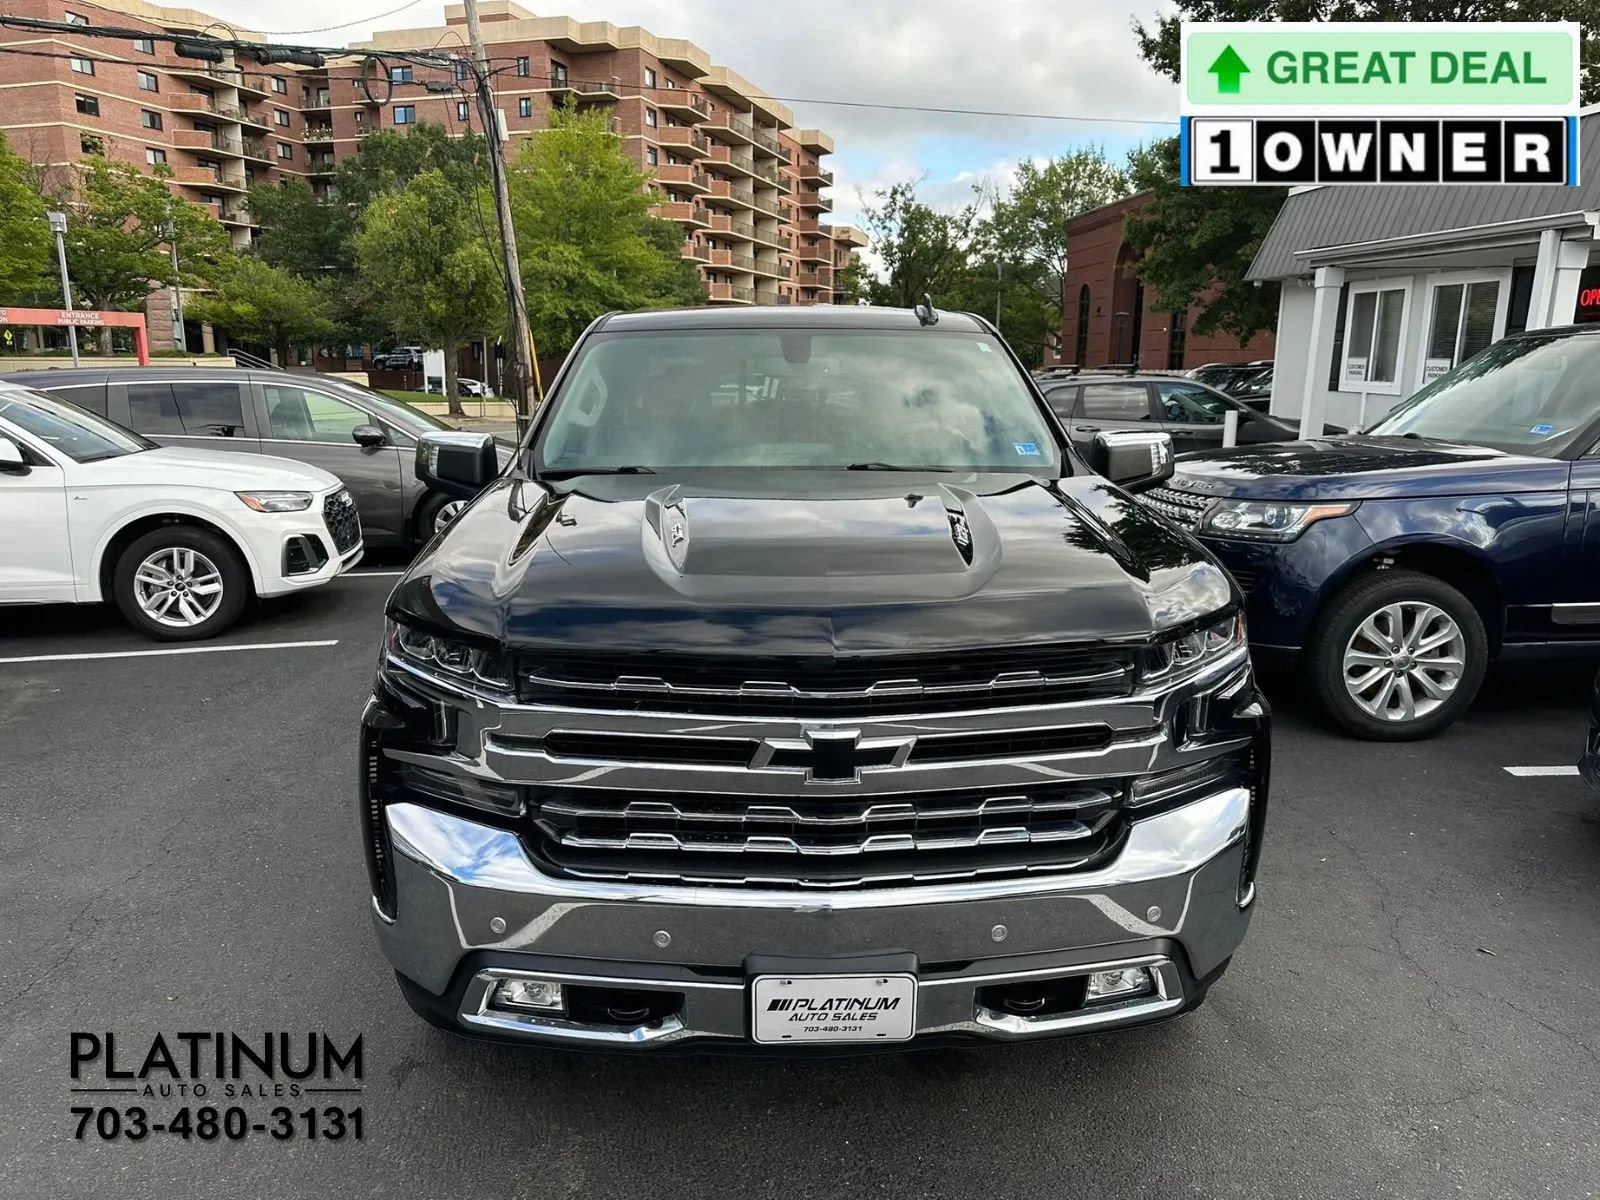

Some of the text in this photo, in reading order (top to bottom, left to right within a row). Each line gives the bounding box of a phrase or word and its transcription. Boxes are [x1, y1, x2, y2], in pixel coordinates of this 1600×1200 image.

[61, 311, 99, 319] ENTRANCE
[791, 997, 901, 1011] PLATINUM
[788, 1012, 878, 1022] AUTO SALES
